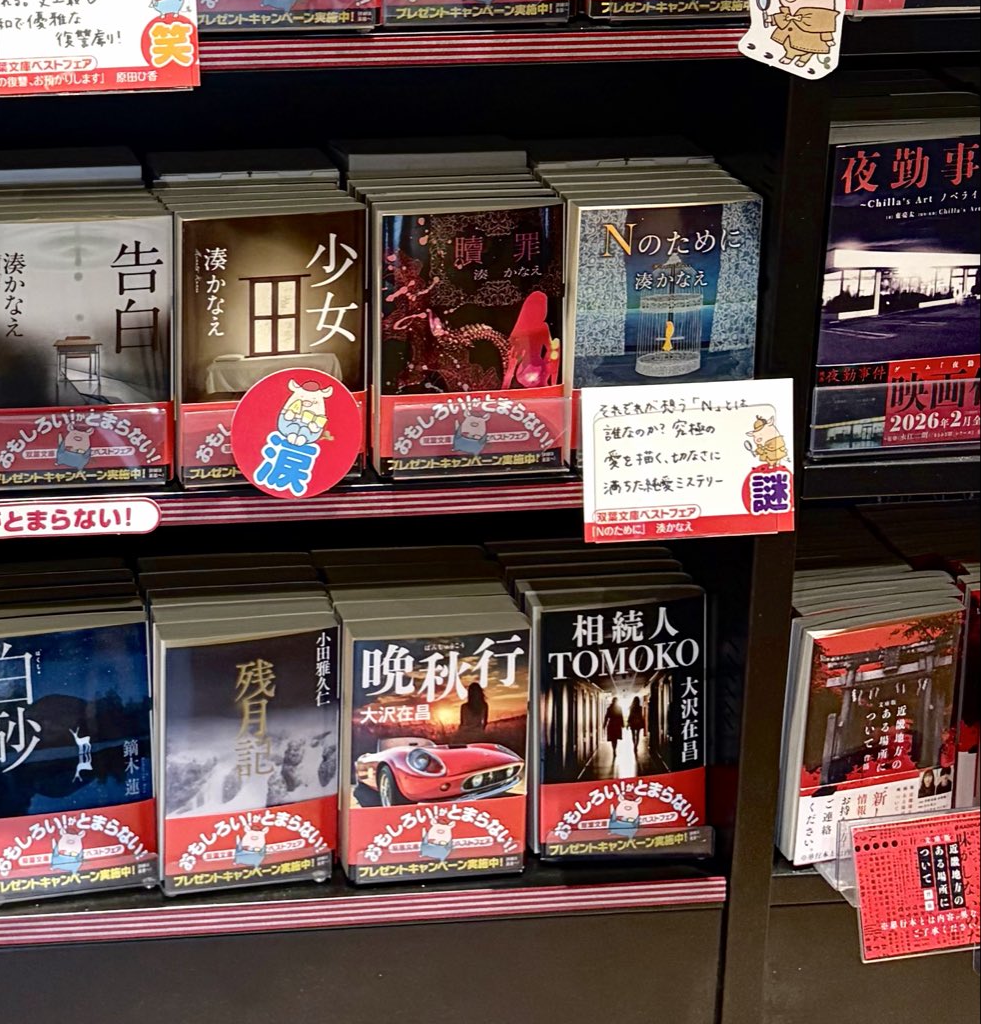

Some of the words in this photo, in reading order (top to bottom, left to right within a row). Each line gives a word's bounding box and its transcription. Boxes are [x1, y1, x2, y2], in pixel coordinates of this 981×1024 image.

[55, 29, 122, 49] 復讐劇!
[148, 22, 194, 68] 笑
[116, 70, 159, 83] 原田ひ香
[840, 142, 981, 195] 夜勤事
[914, 195, 933, 205] Art
[601, 221, 742, 259] Nのために
[1, 251, 27, 339] 湊かなえ
[109, 239, 165, 355] 告白
[203, 246, 229, 338] 湊かなえ
[304, 231, 360, 348] 少女
[634, 271, 709, 291] 湊かなえ
[256, 433, 320, 497] 涙
[603, 474, 725, 496] 満ちた純愛ミステリー
[596, 507, 697, 522] 双葉文庫ベストフェア
[751, 472, 790, 514] 謎
[655, 522, 694, 533] 湊かなえ
[571, 605, 681, 649] 相続人
[314, 631, 333, 708] 小田雅久仁
[361, 634, 525, 702] 晩秋行
[547, 637, 701, 681] TOMOKO
[234, 658, 277, 777] 残月記
[359, 703, 432, 726] 大沢在昌
[679, 676, 700, 764] 大沢在昌
[863, 712, 877, 749] ついて
[875, 708, 892, 773] ある場所に
[891, 704, 908, 770] 近畿地方の
[820, 798, 836, 836] ご連絡
[548, 832, 688, 858] プレゼントキャンペーン実施中!
[358, 857, 504, 880] プレゼントキャンペーン実施中!
